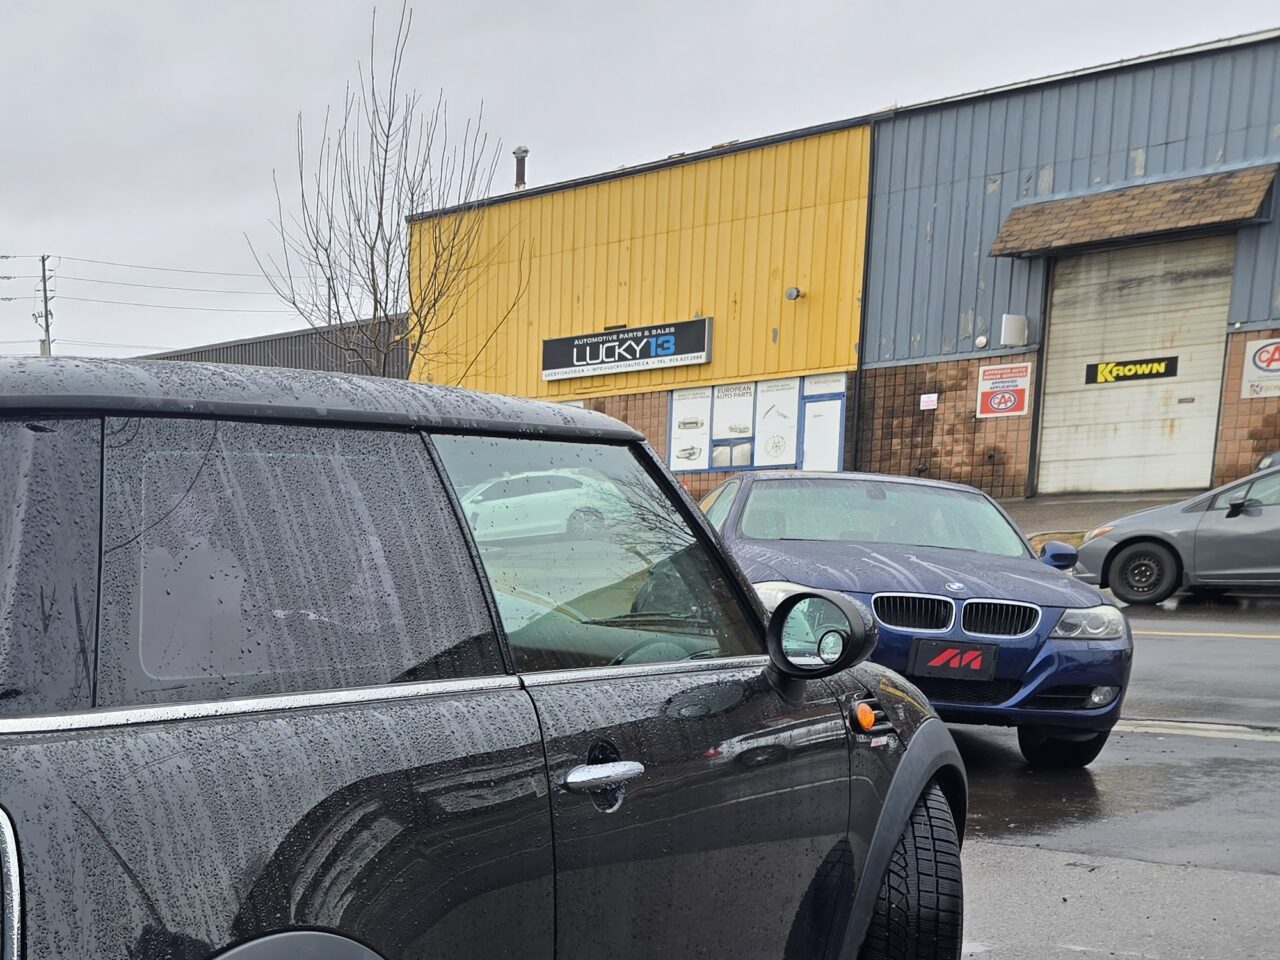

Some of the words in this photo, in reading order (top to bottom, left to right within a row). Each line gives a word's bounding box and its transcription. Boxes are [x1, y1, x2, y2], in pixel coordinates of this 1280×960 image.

[573, 334, 618, 345] AUTOMOTIVE
[619, 331, 642, 340] PARTS
[651, 326, 676, 335] SALES
[717, 385, 752, 394] EUROPEAN
[733, 391, 753, 399] PARTS
